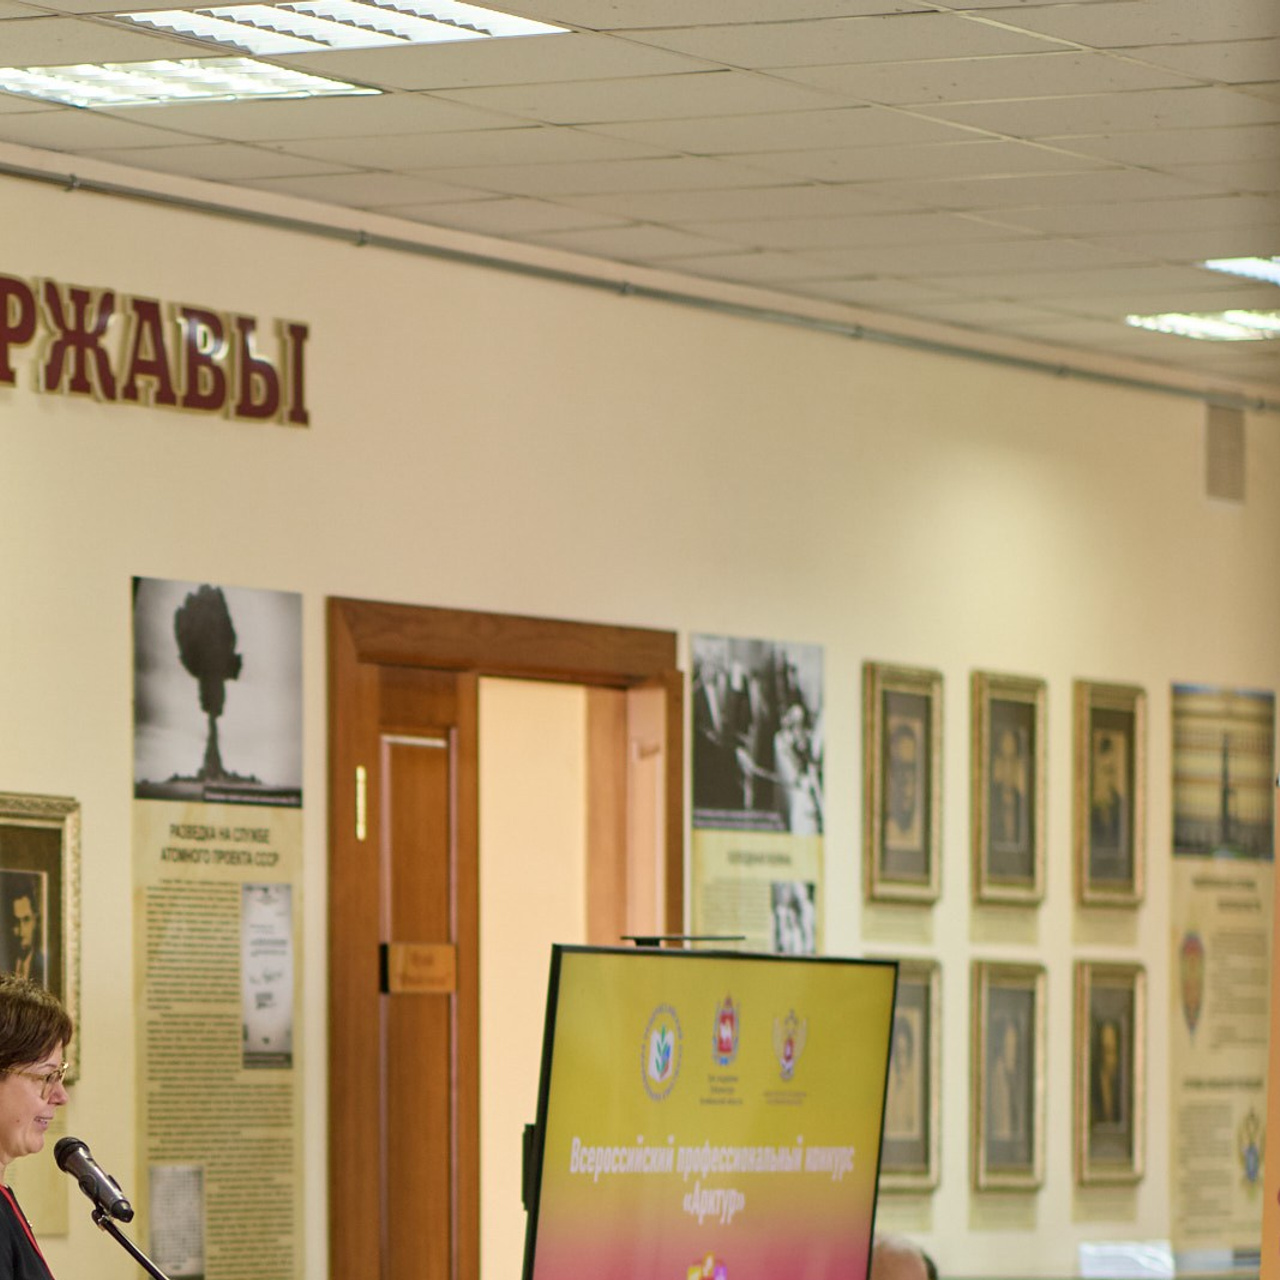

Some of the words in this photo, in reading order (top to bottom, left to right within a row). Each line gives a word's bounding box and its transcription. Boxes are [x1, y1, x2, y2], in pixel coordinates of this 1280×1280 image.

[161, 846, 210, 864] АТОМНОГО
[213, 849, 253, 866] ПРОЕКТА
[570, 1136, 675, 1182] Всероссийский
[676, 1134, 803, 1180] профессиональный
[804, 1145, 855, 1181] конкурс
